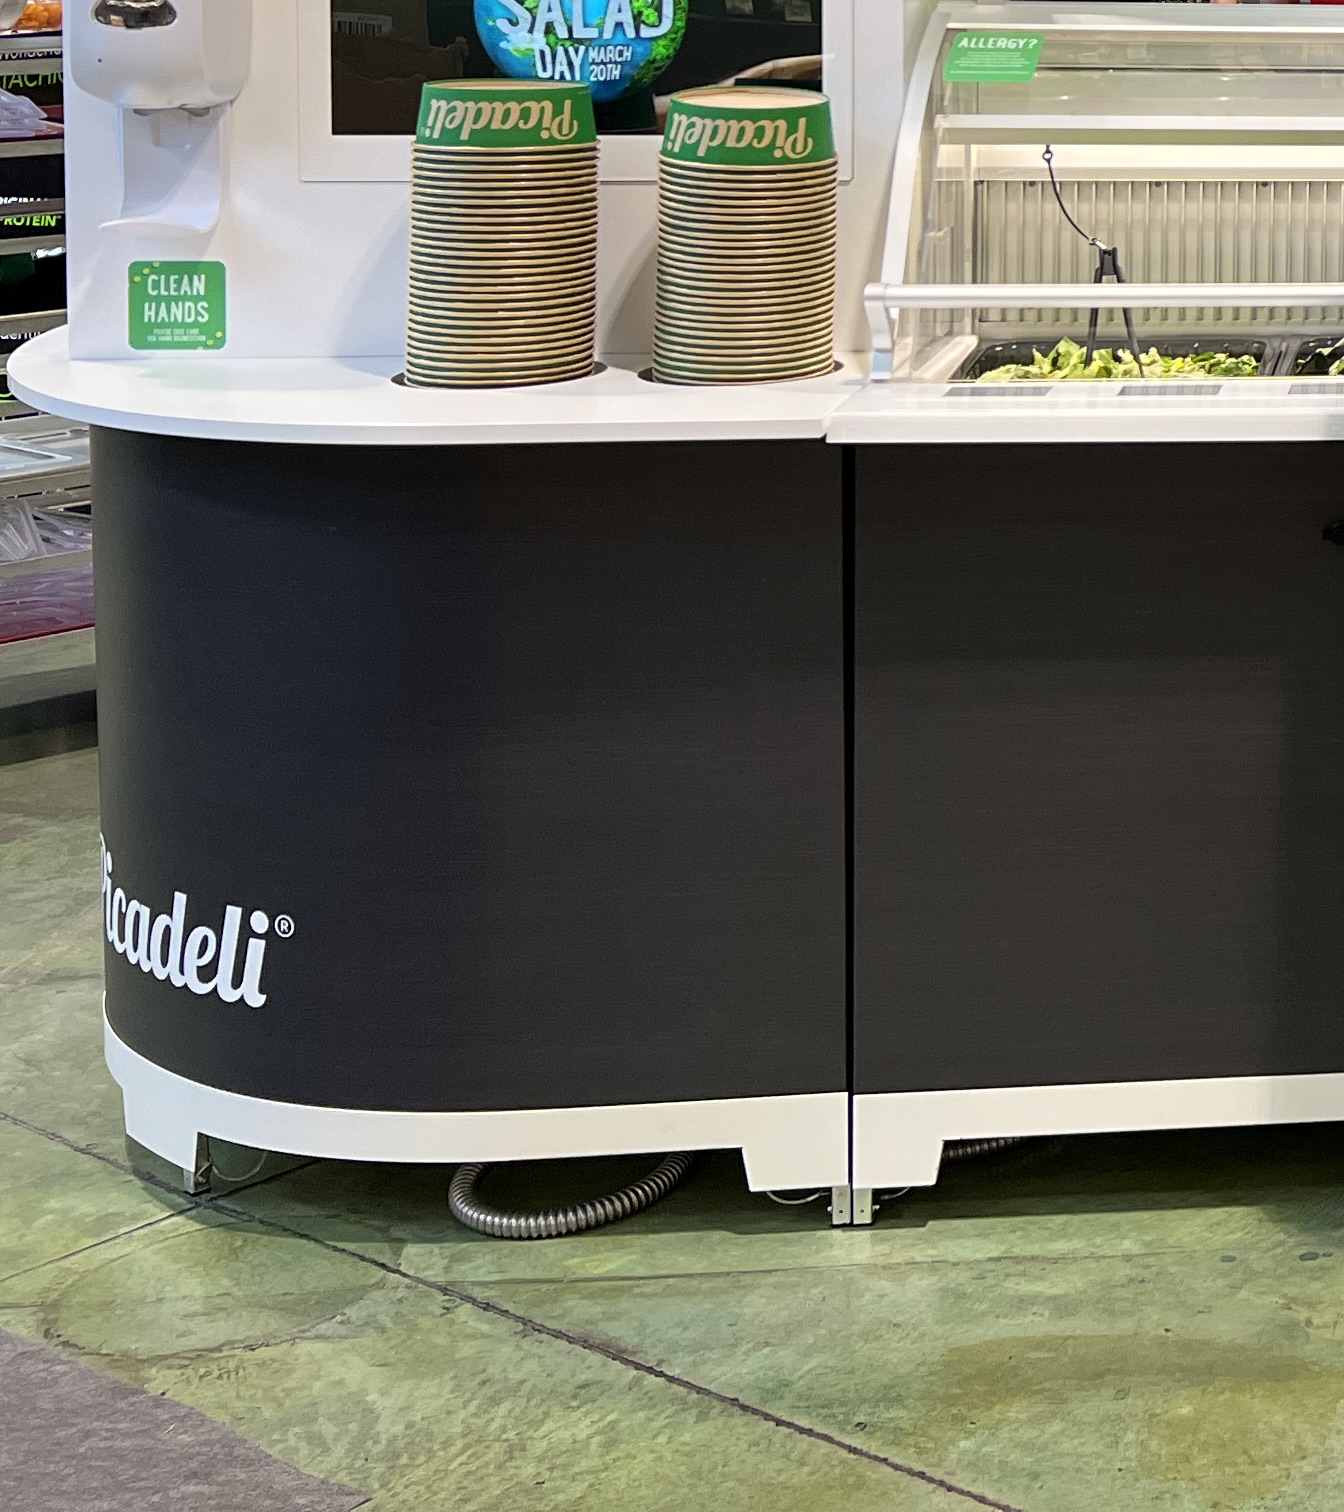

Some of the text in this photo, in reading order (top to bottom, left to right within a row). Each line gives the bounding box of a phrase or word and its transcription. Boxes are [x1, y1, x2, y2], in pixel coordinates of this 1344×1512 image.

[588, 45, 633, 63] MARCH
[957, 37, 1038, 49] ALLERGY?
[534, 45, 586, 81] DAY
[589, 64, 622, 82] 20TH
[425, 97, 579, 141] Picadeli
[669, 112, 814, 160] Picadeli
[147, 273, 206, 296] CLEAN
[143, 301, 209, 323] HANDS
[100, 831, 294, 1008] icadeli®
